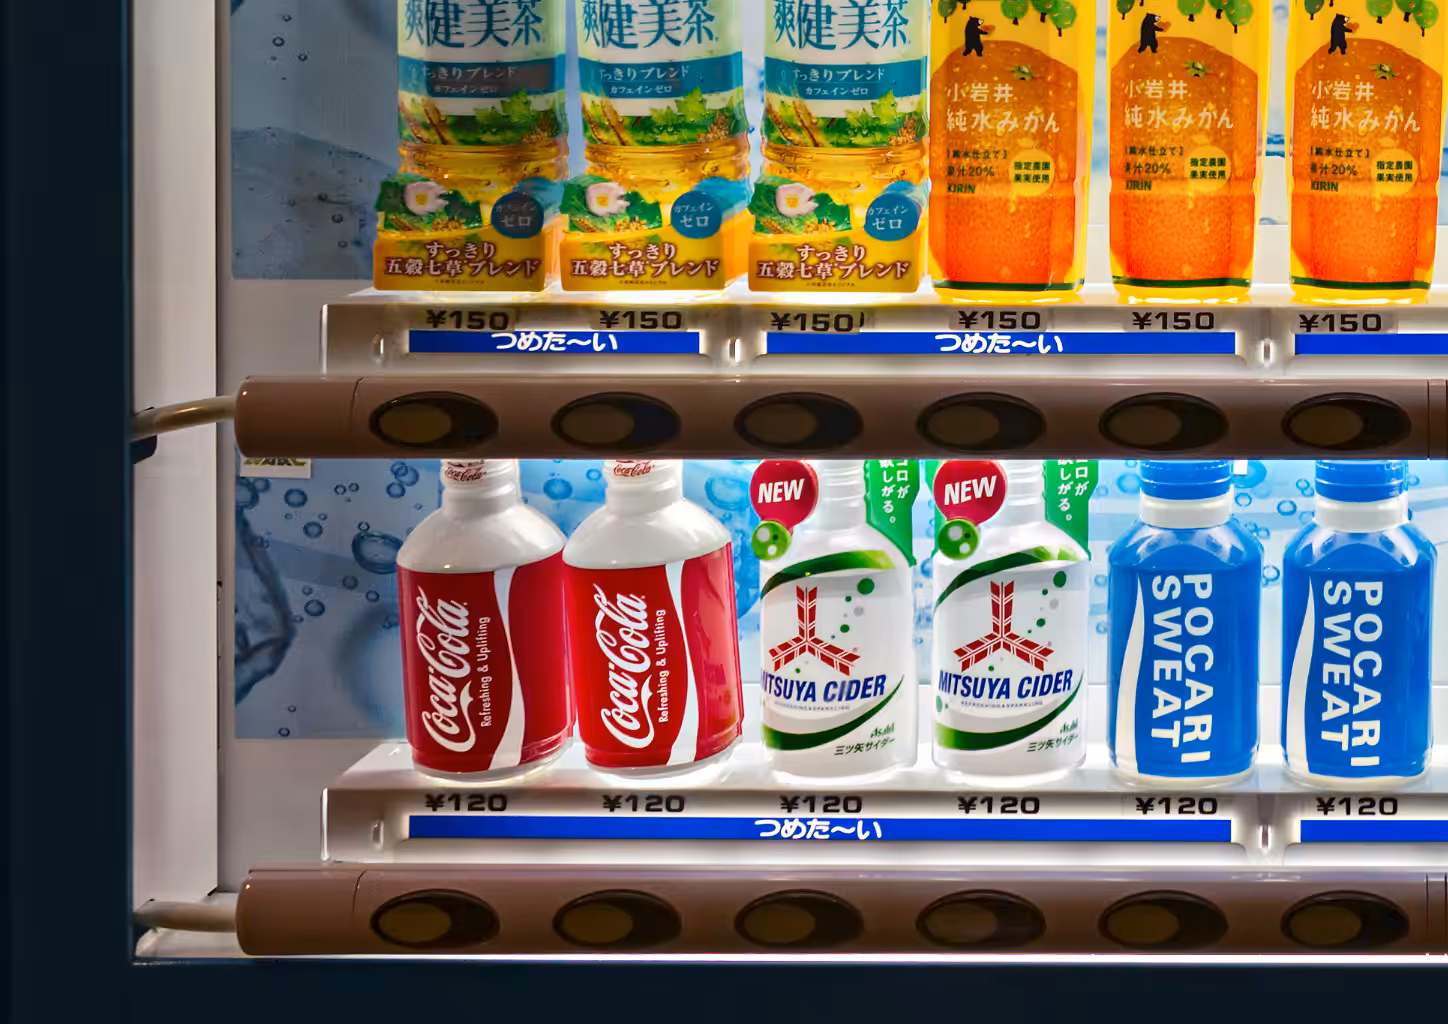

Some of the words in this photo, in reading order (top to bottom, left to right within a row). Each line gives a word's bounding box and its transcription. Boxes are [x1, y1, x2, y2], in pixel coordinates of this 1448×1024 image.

[946, 82, 1013, 103] 小岩井
[1311, 80, 1374, 101] 小岩井
[946, 108, 1060, 133] 純水みかん
[1310, 107, 1421, 133] 純水みかん
[609, 243, 677, 260] すっきり
[797, 245, 866, 262] すっきり
[426, 310, 510, 330] ¥150
[600, 311, 683, 329] ¥150
[771, 312, 854, 331] ¥150
[959, 311, 1041, 330] ¥150
[1133, 311, 1215, 330] ¥150
[1299, 313, 1382, 332] ¥150
[757, 479, 805, 503] NEW
[944, 476, 997, 506] NEW
[475, 617, 491, 662] Uplifting
[654, 609, 668, 656] Uplifting
[416, 585, 477, 753] Coca-Cola
[593, 583, 655, 749] Coca-Cola
[1151, 574, 1183, 748] SWEAT
[1181, 573, 1214, 763] POCARI
[1321, 580, 1352, 751] SWEAT
[938, 668, 1011, 699] MITSUYA
[1016, 669, 1074, 699] CIDER
[1350, 580, 1383, 767] POCARI
[657, 669, 670, 723] Refreshing
[823, 674, 887, 702] CIDER
[481, 675, 492, 727] Refreshing
[425, 793, 508, 812] ¥120
[603, 794, 685, 812] ¥120
[780, 795, 863, 813] ¥120
[958, 796, 1040, 814] ¥120
[1136, 797, 1218, 814] ¥120
[1317, 797, 1399, 815] ¥120
